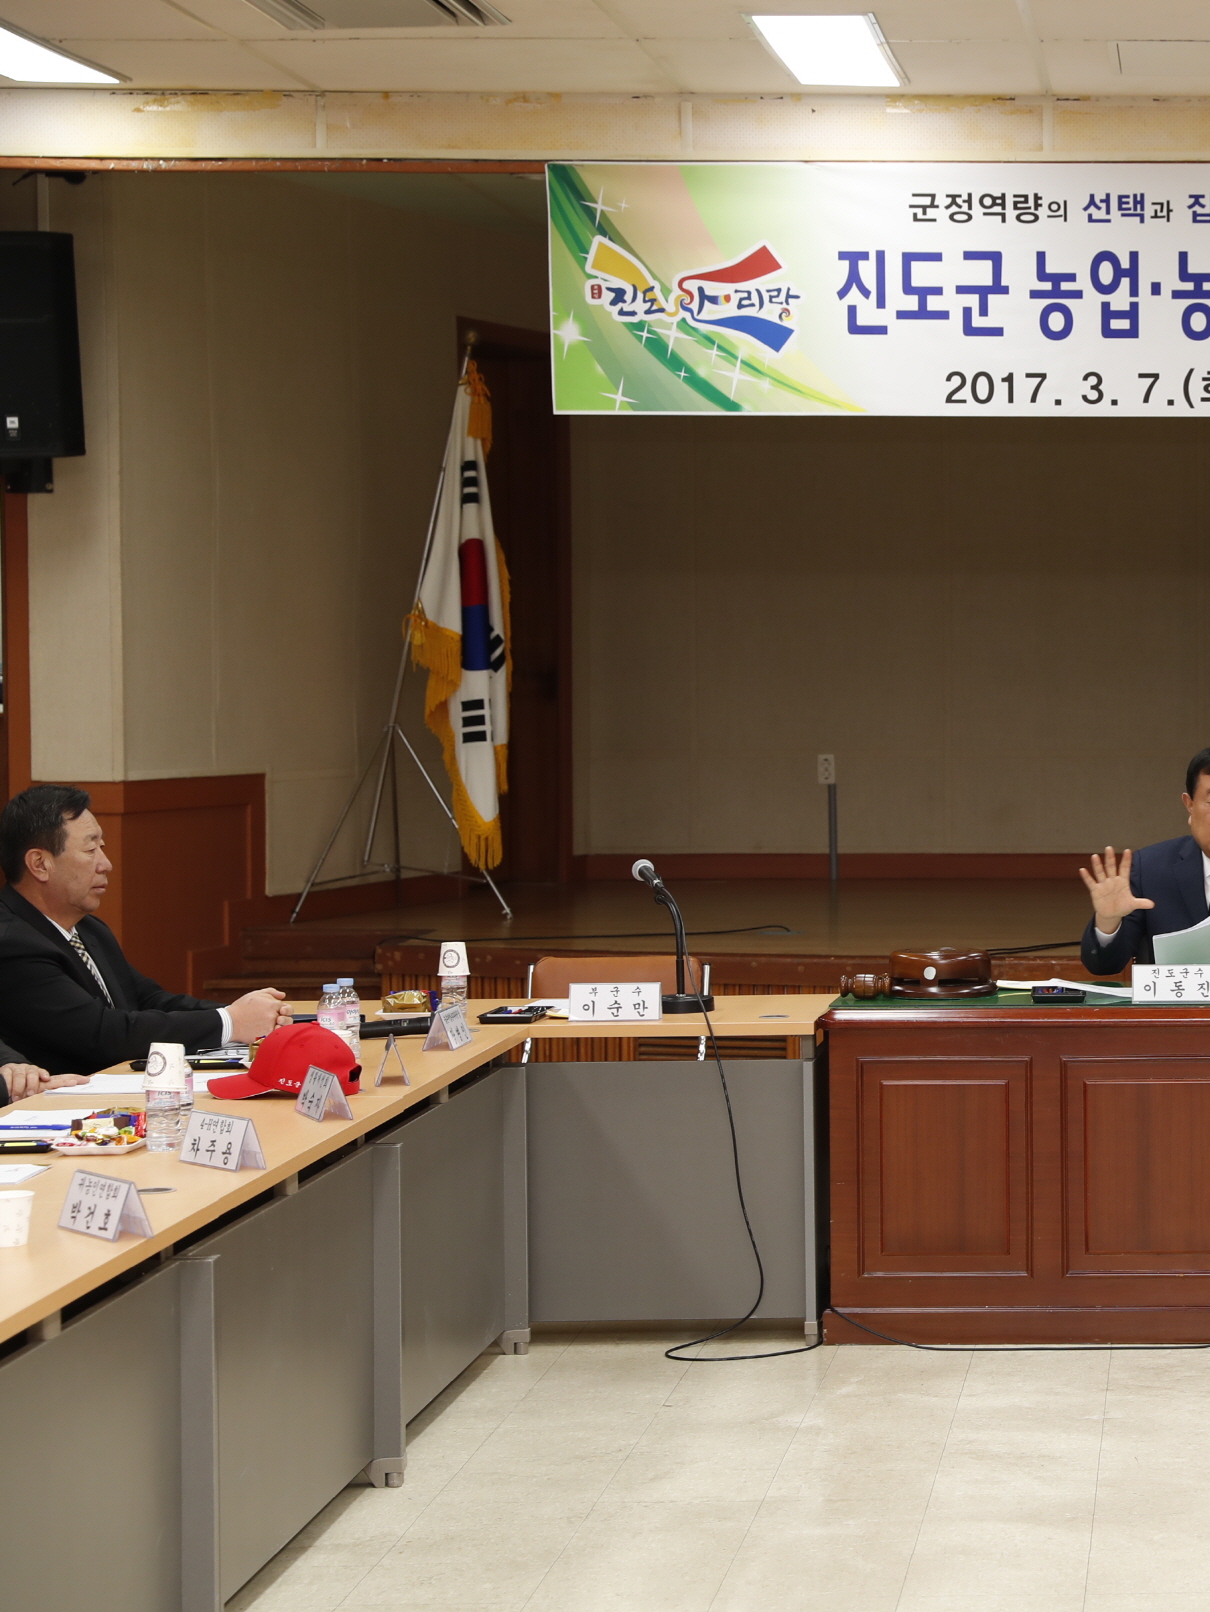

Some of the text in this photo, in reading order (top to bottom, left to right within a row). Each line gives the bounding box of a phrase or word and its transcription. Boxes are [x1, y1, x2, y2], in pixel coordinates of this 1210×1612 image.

[908, 192, 1068, 224] 군정역량의
[1082, 192, 1173, 224] 선택과
[605, 284, 666, 317] 진도
[836, 249, 1010, 337] 진도군
[945, 371, 1062, 406] 2017.
[1081, 371, 1119, 406] 3.
